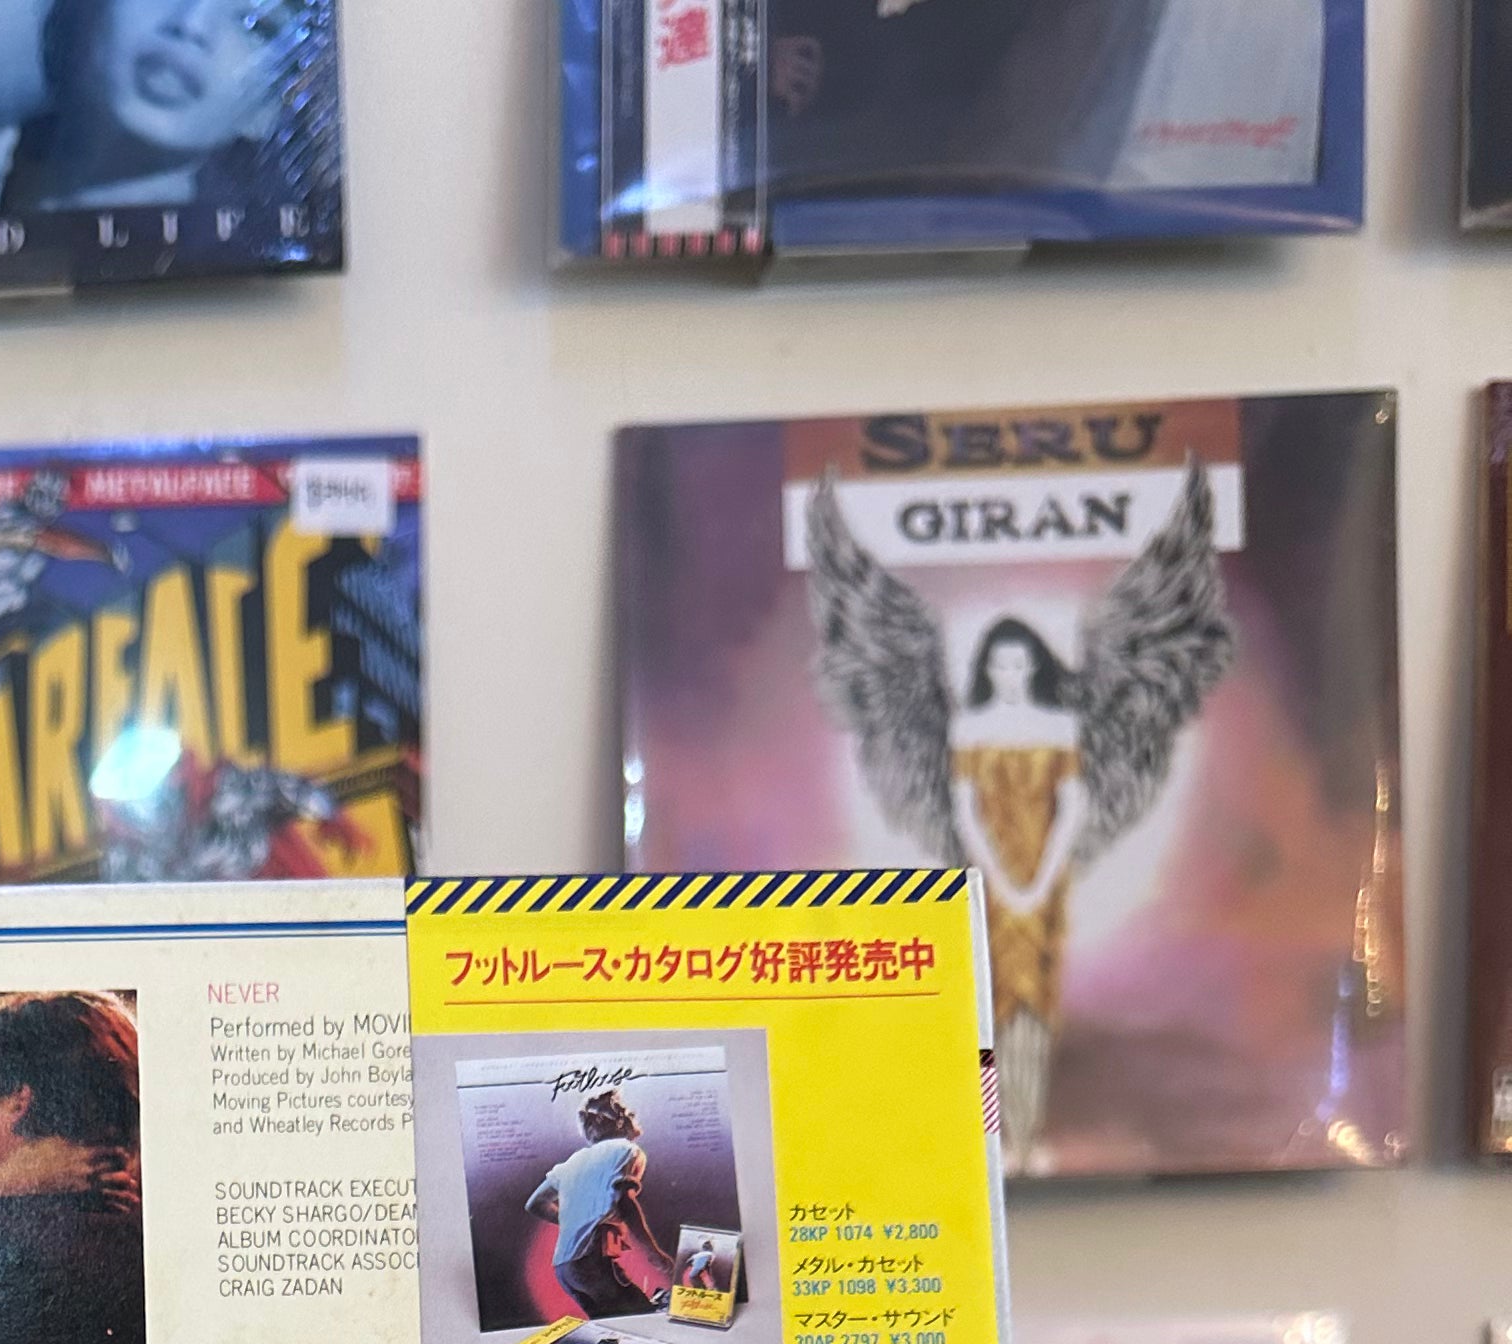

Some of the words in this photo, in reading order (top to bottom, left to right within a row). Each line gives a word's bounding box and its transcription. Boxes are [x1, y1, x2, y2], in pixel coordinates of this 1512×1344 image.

[862, 410, 1161, 472] SERU
[896, 492, 1131, 543] GIRAN
[445, 936, 935, 986] フットルース・カタログ好評発売中
[207, 982, 280, 1005] NEVER
[214, 1179, 343, 1201] SOUNDTRACK
[216, 1205, 277, 1225] BECKY
[789, 1202, 855, 1222] カセット
[792, 1254, 924, 1276] メタル・カセット
[219, 1278, 275, 1298] CRAIG
[281, 1277, 343, 1297] ZADAN
[794, 1308, 956, 1330] マスター・サウンド
